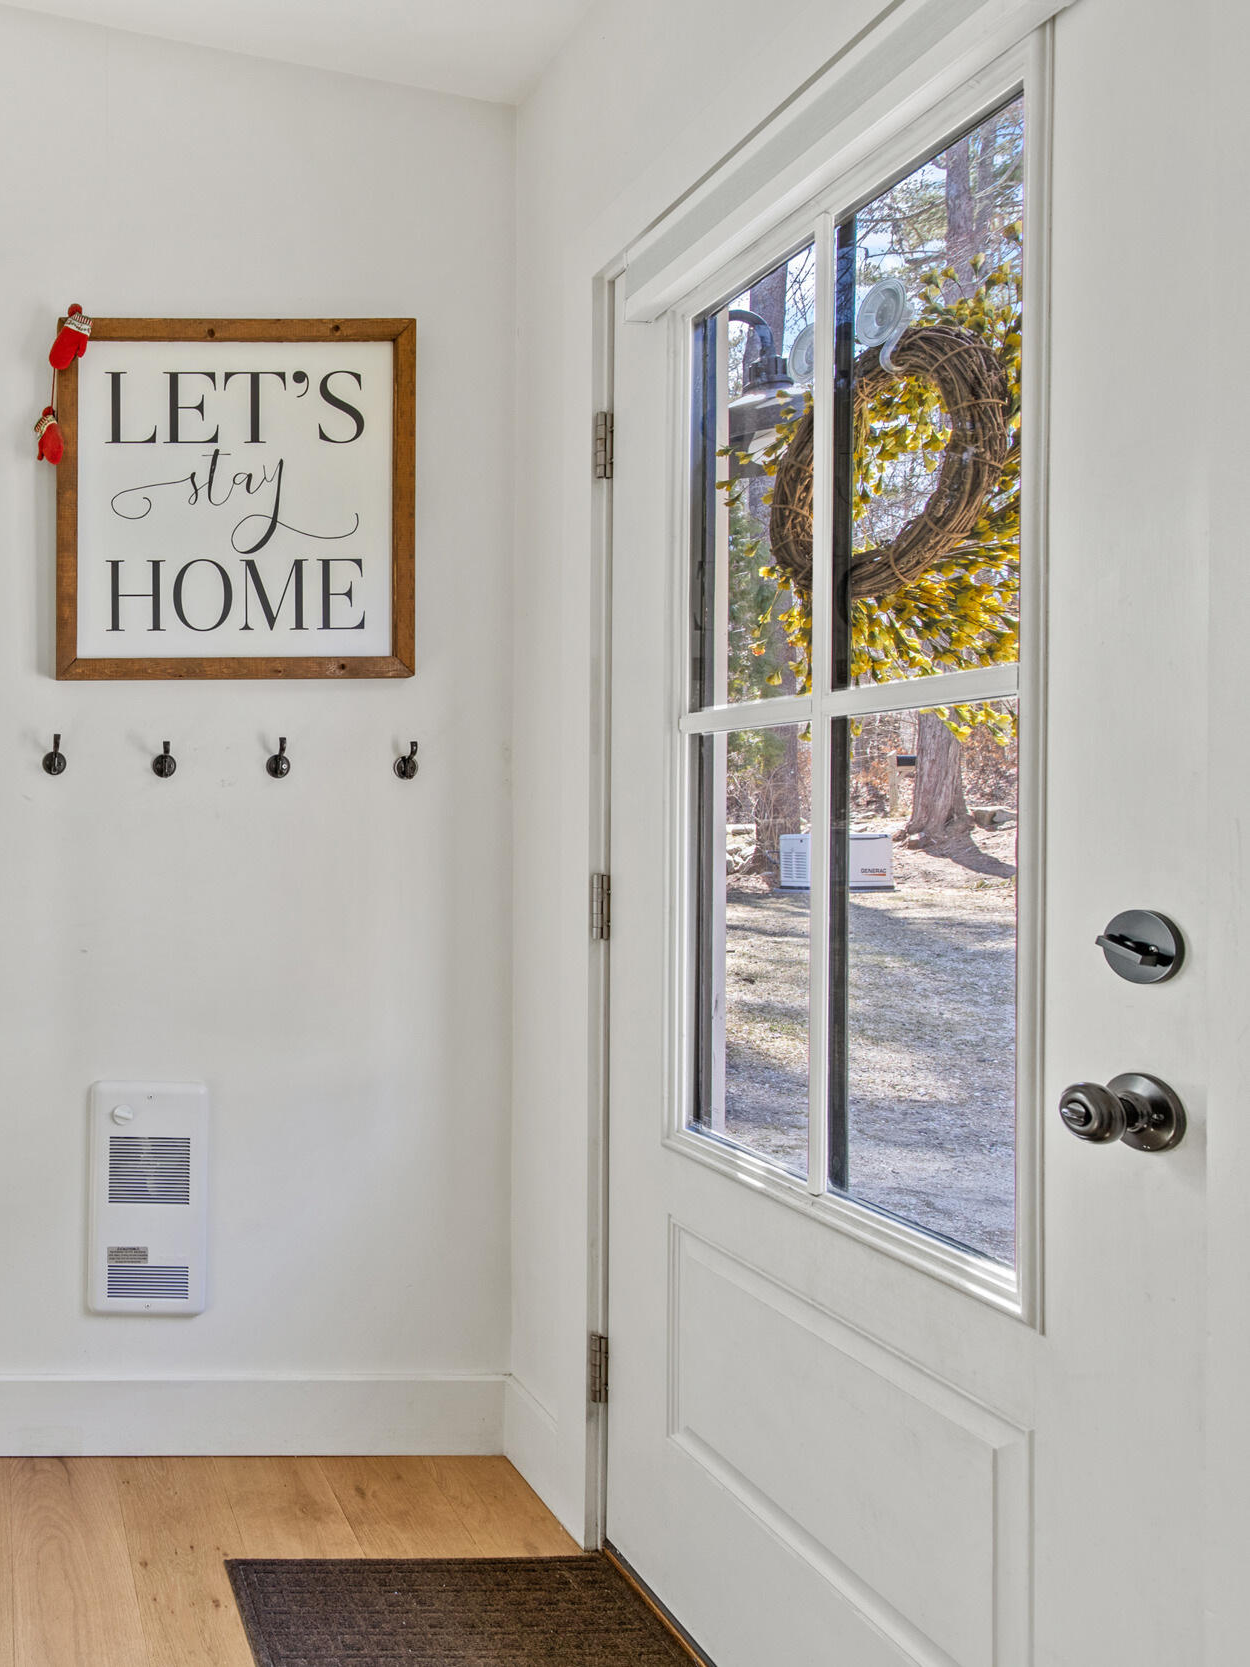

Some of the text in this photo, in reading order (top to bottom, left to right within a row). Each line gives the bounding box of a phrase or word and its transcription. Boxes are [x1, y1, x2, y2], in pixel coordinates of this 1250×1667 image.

[105, 370, 365, 444] LET'S
[111, 449, 359, 554] stay
[106, 558, 366, 631] HOME
